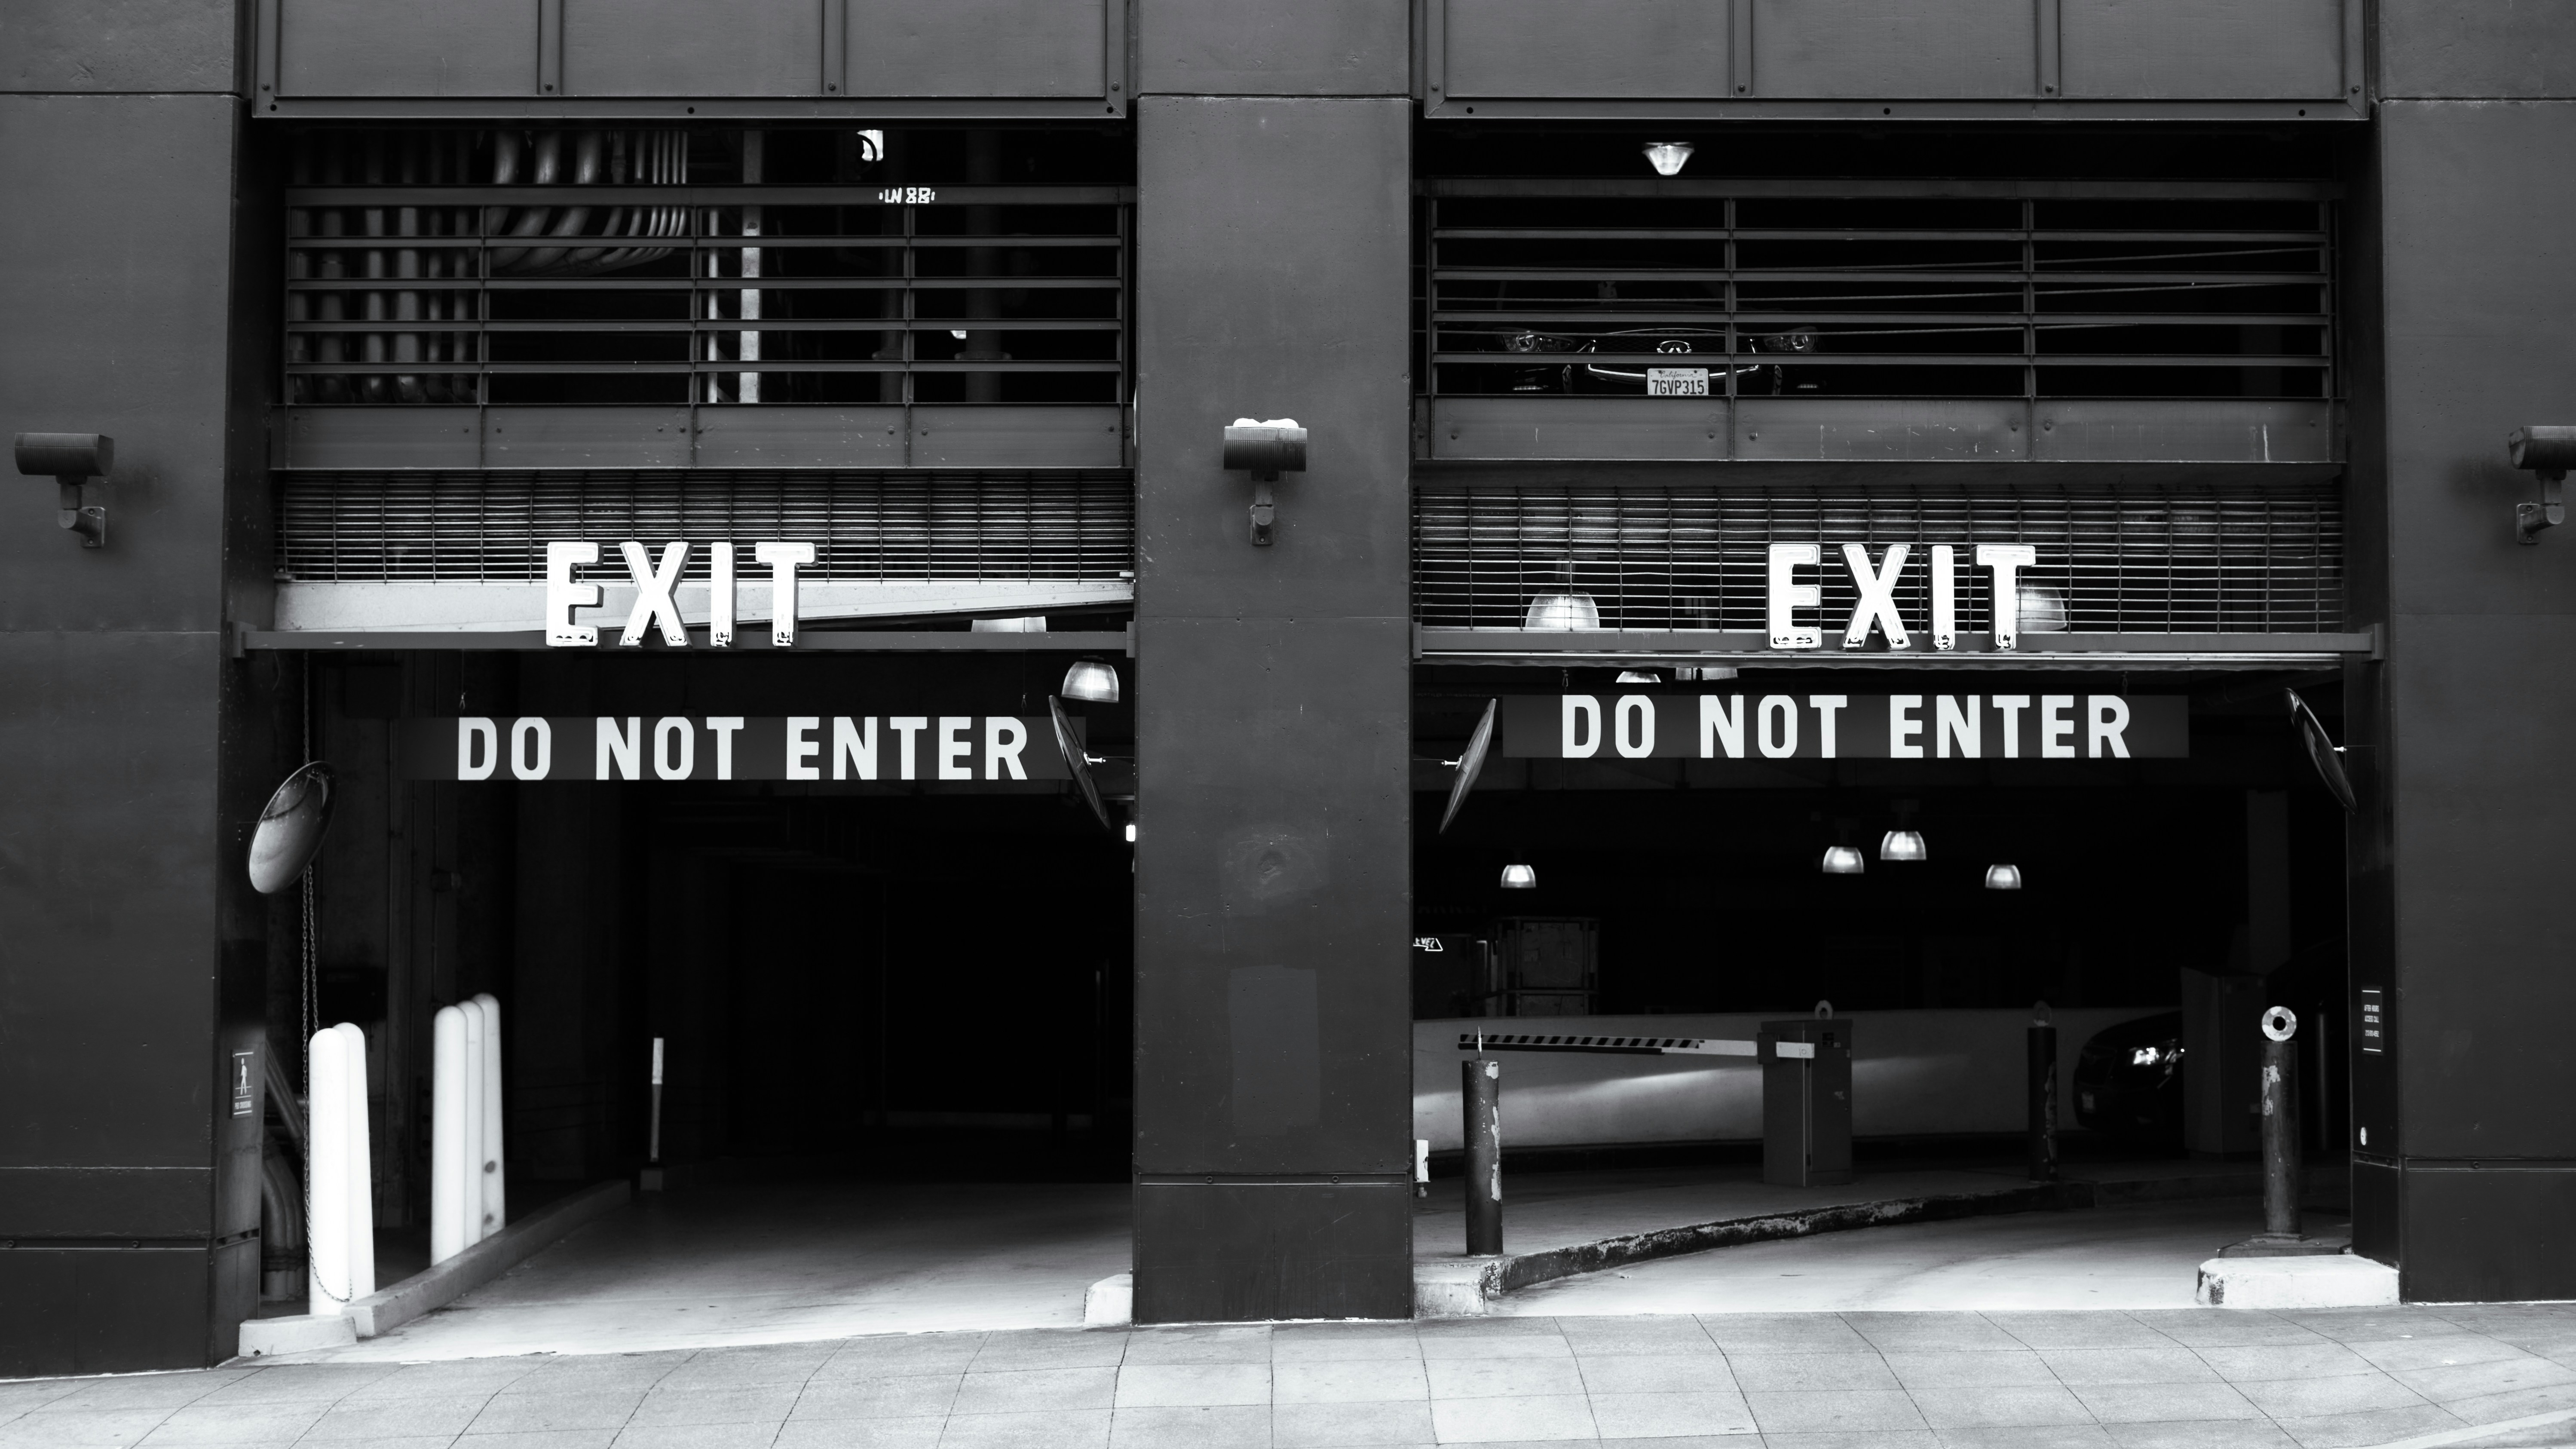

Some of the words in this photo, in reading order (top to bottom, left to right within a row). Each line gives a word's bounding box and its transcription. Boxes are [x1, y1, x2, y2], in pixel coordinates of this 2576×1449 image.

[1652, 380, 1704, 394] 7GVP315
[1660, 370, 1697, 379] California
[546, 541, 818, 648] EXIT
[1765, 543, 2036, 650] EXIT
[1562, 695, 1655, 758] DO
[1700, 695, 1847, 758] NOT
[1890, 695, 2131, 758] ENTER
[458, 717, 551, 781] DO
[596, 717, 744, 780] NOT
[787, 717, 1028, 780] ENTER
[1414, 937, 1435, 949] EVEL
[239, 1100, 251, 1109] CROSSING
